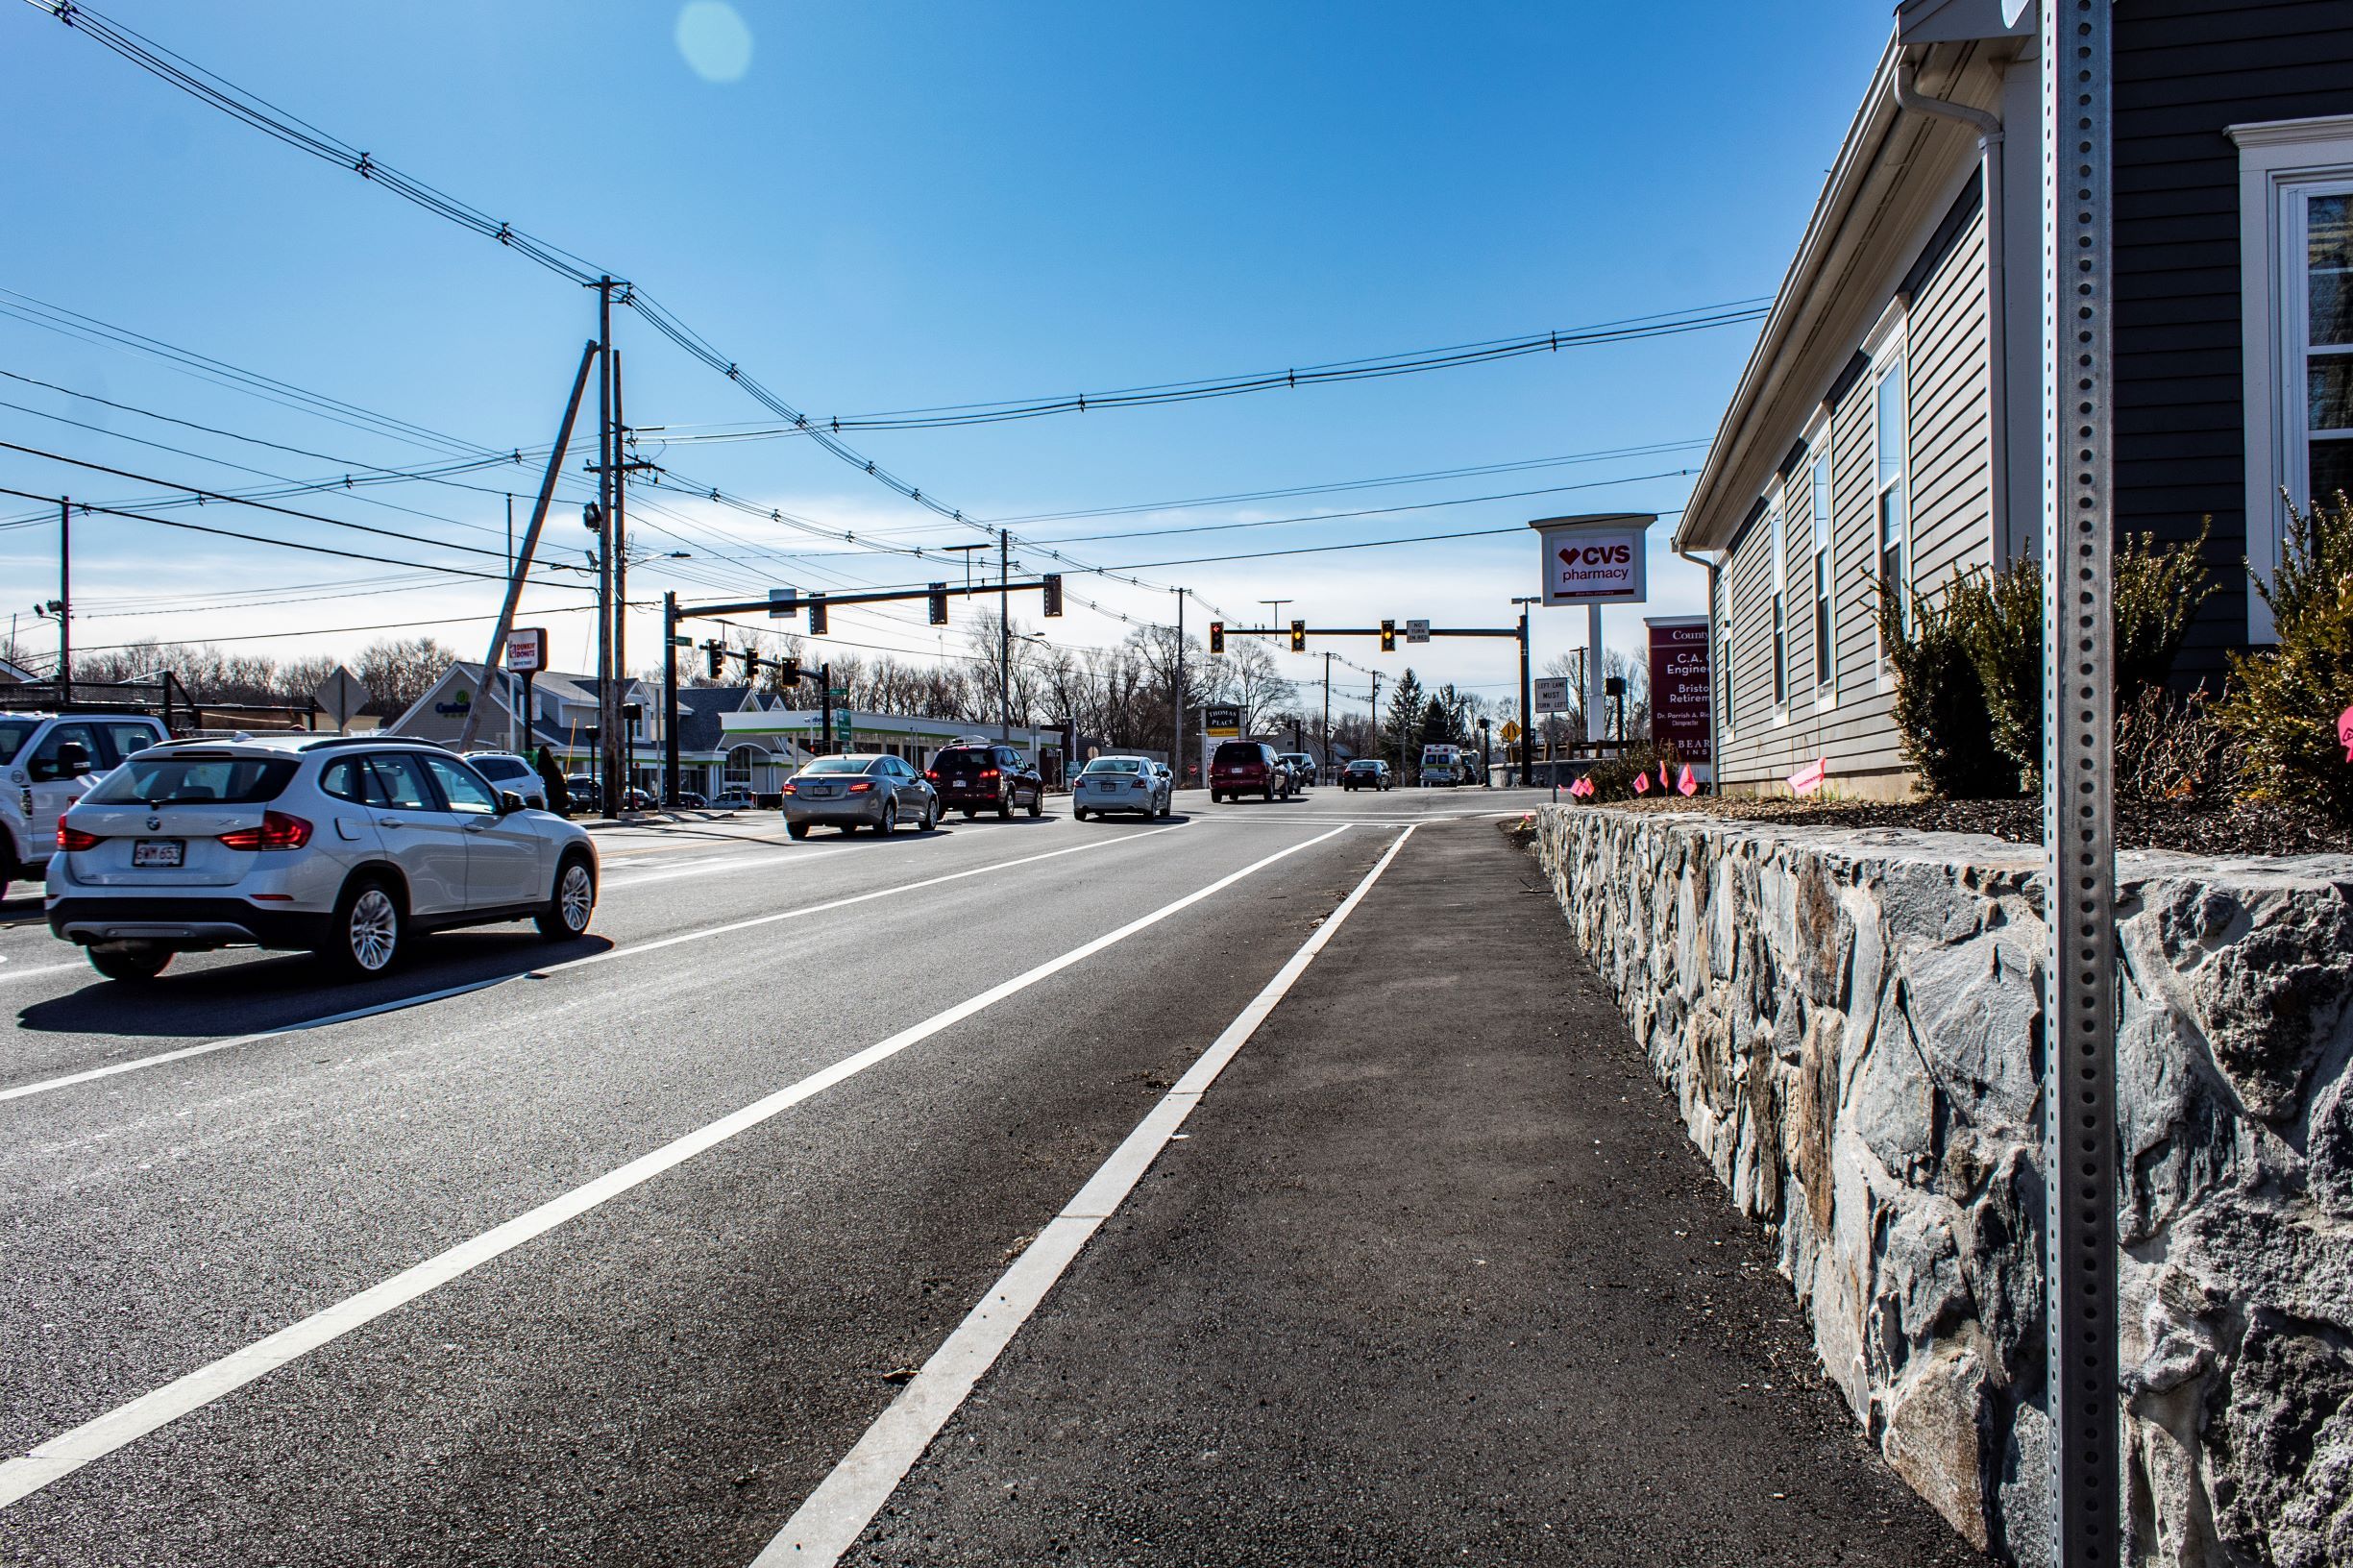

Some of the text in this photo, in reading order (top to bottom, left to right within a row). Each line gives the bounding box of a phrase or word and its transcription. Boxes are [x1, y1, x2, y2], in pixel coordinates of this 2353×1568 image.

[1582, 545, 1630, 565] CVS
[1563, 569, 1629, 583] pharmacy
[1672, 630, 1708, 640] County
[516, 649, 534, 658] DONUTS
[1677, 653, 1703, 663] C.A.
